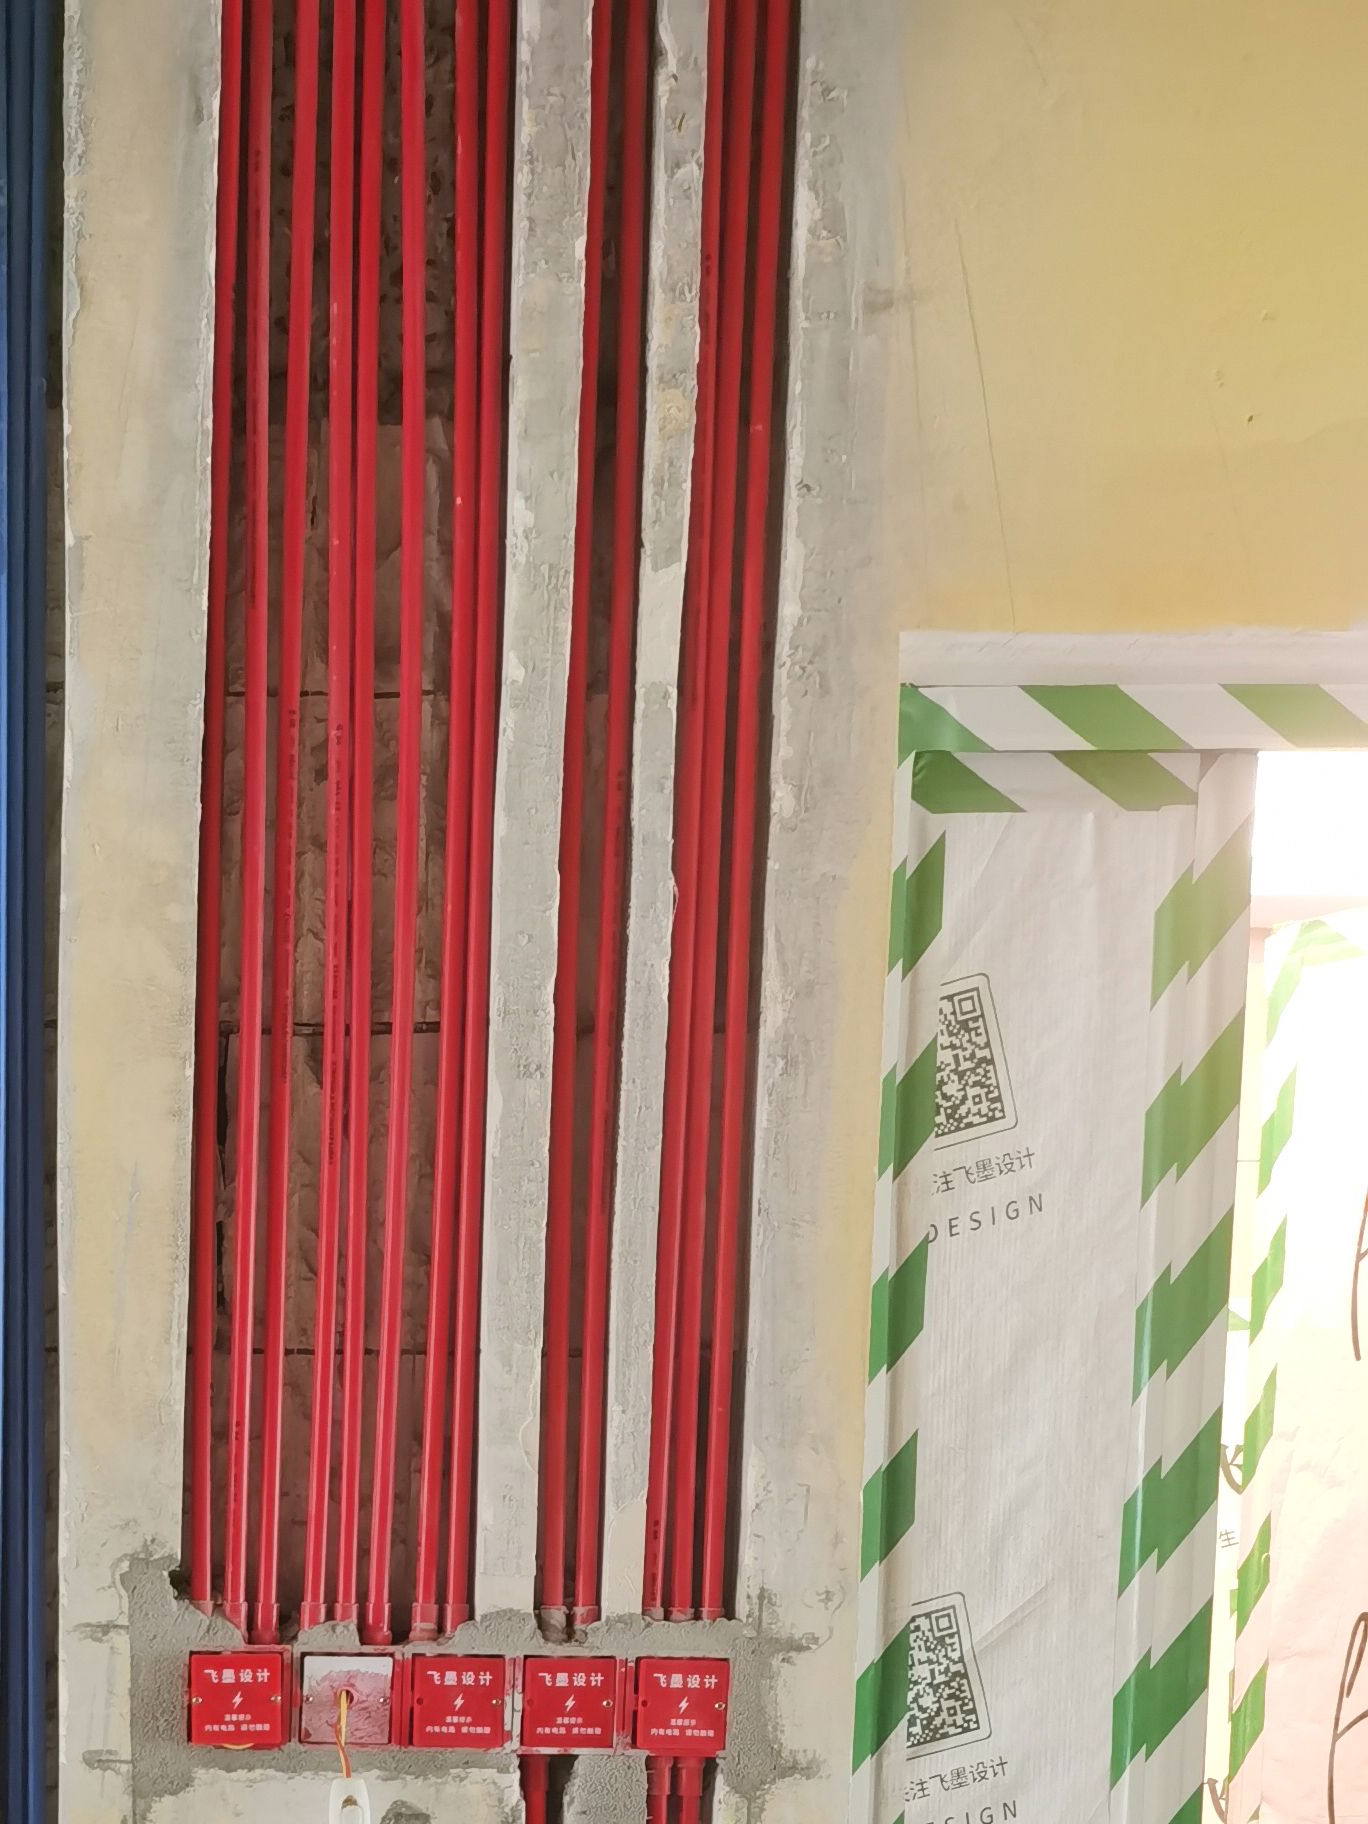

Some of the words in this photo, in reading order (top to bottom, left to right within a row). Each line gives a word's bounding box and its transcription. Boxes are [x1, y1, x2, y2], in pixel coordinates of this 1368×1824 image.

[932, 1147, 1035, 1196] 注飞墨设计
[904, 1756, 1008, 1802] 注飞墨设计
